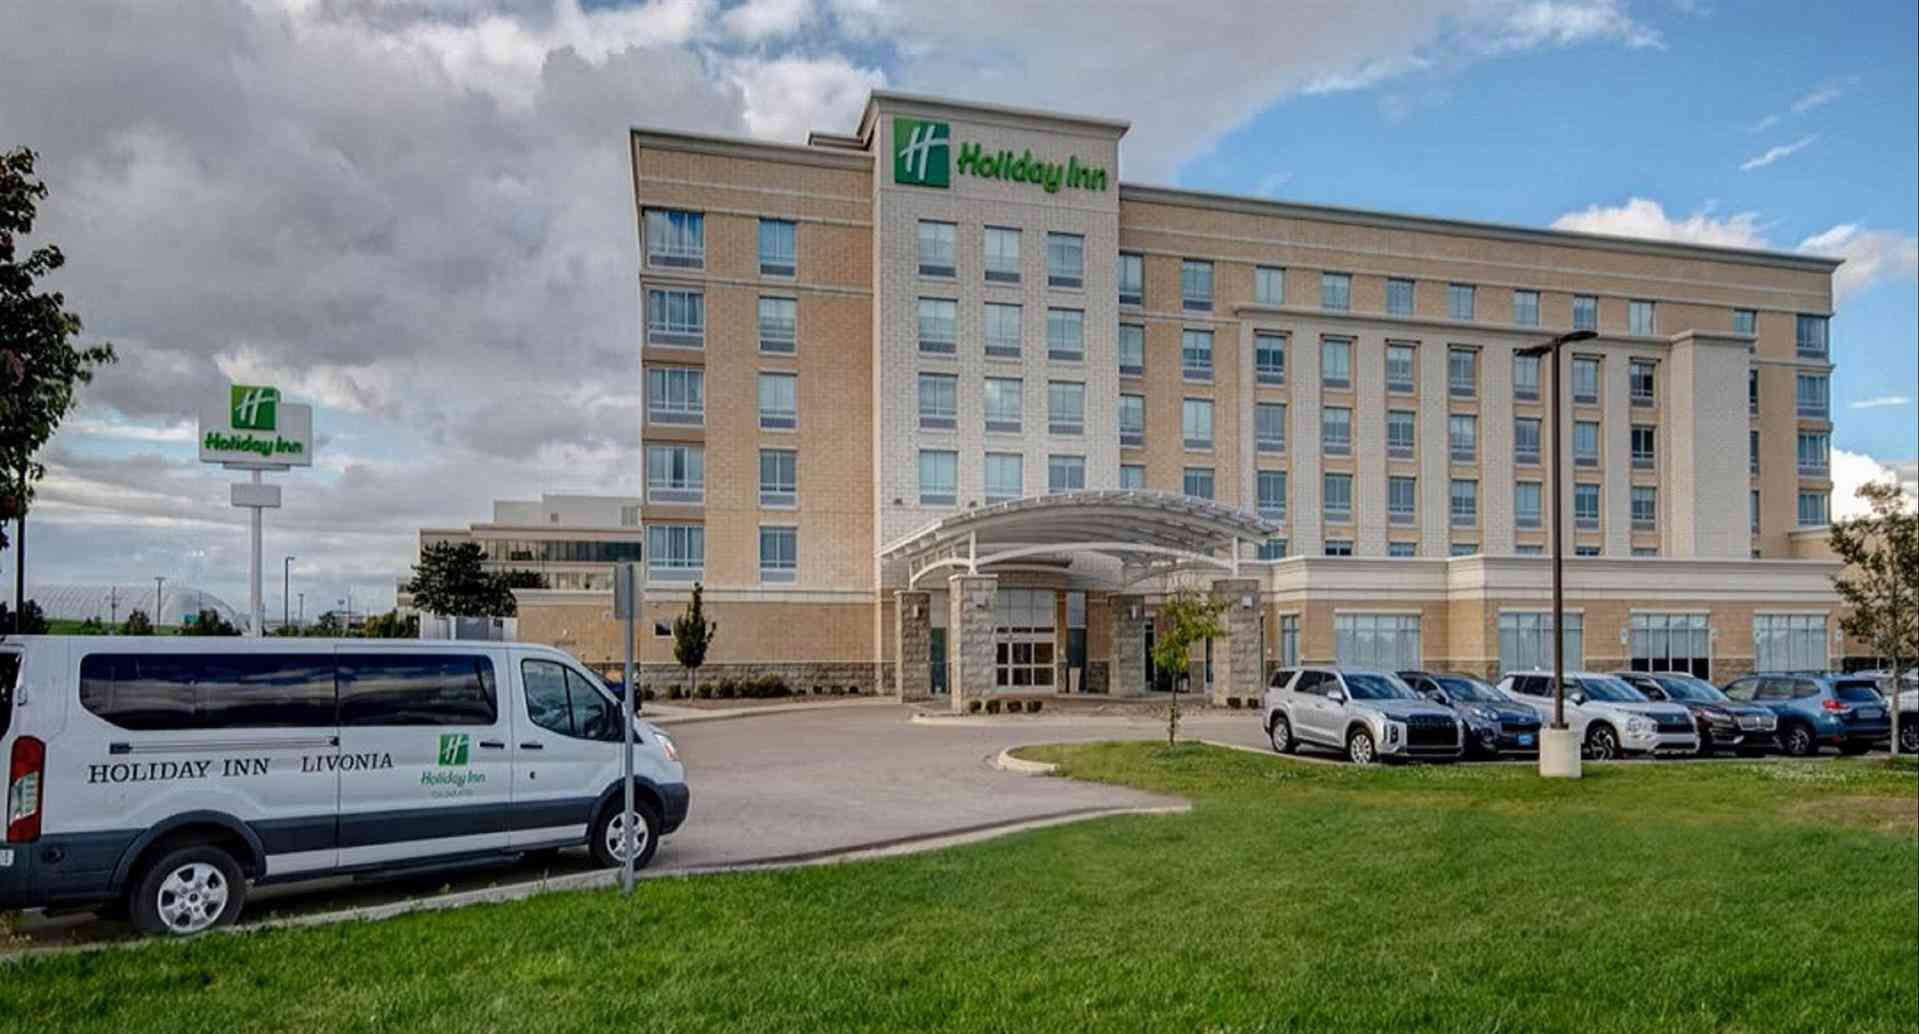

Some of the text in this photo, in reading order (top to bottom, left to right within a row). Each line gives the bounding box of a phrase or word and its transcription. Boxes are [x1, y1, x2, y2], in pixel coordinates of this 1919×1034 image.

[957, 142, 1107, 193] Holiday Inn
[204, 432, 304, 456] Holiday Inn
[88, 753, 394, 784] HOLIDAY INN LIVONIA
[421, 770, 486, 787] Holiday Inn
